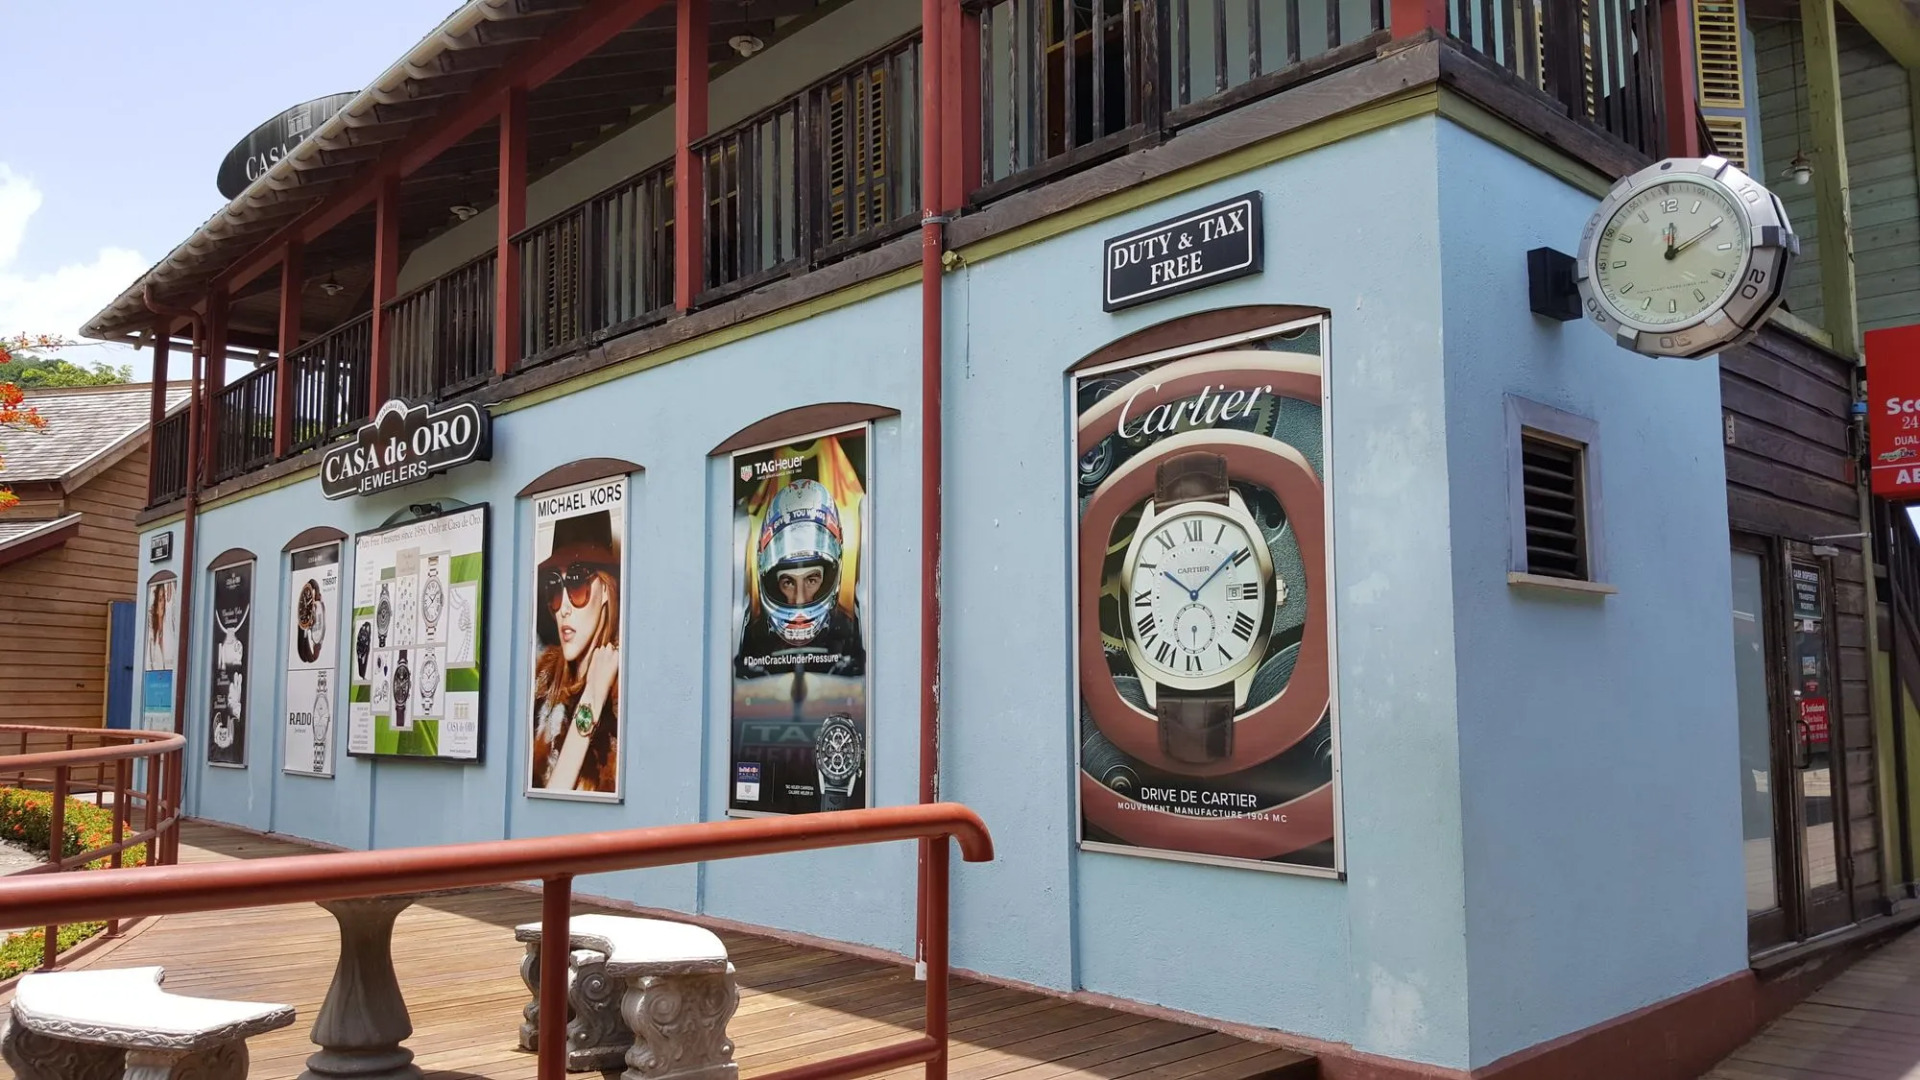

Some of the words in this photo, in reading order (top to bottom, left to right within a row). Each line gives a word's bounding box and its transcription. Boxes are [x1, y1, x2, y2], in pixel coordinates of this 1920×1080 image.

[246, 143, 289, 181] CASA
[1660, 198, 1679, 214] 12
[1114, 232, 1171, 269] DUTY
[1178, 232, 1193, 250] &
[1199, 208, 1246, 243] TAX
[1150, 250, 1203, 285] FREE
[1741, 268, 1766, 300] 20
[1117, 383, 1272, 440] Cartier
[1902, 415, 1919, 429] 24
[325, 443, 380, 483] CASA
[384, 437, 407, 466] de
[412, 414, 471, 456] ORO
[1894, 435, 1919, 446] DUAL
[358, 460, 427, 493] JEWELERS
[537, 493, 586, 517] MICHAEL
[590, 484, 622, 506] KORS
[1177, 565, 1210, 575] CARTIER
[290, 712, 311, 725] RADO
[751, 725, 821, 742] TA
[1141, 787, 1177, 802] DRIVE
[1180, 790, 1198, 804] DE
[1201, 791, 1257, 808] CARTIER
[1117, 801, 1171, 813] MOUVEMENT
[1174, 805, 1243, 819] MANUFACTURE
[1247, 812, 1269, 822] 1904
[1272, 814, 1287, 823] MC
